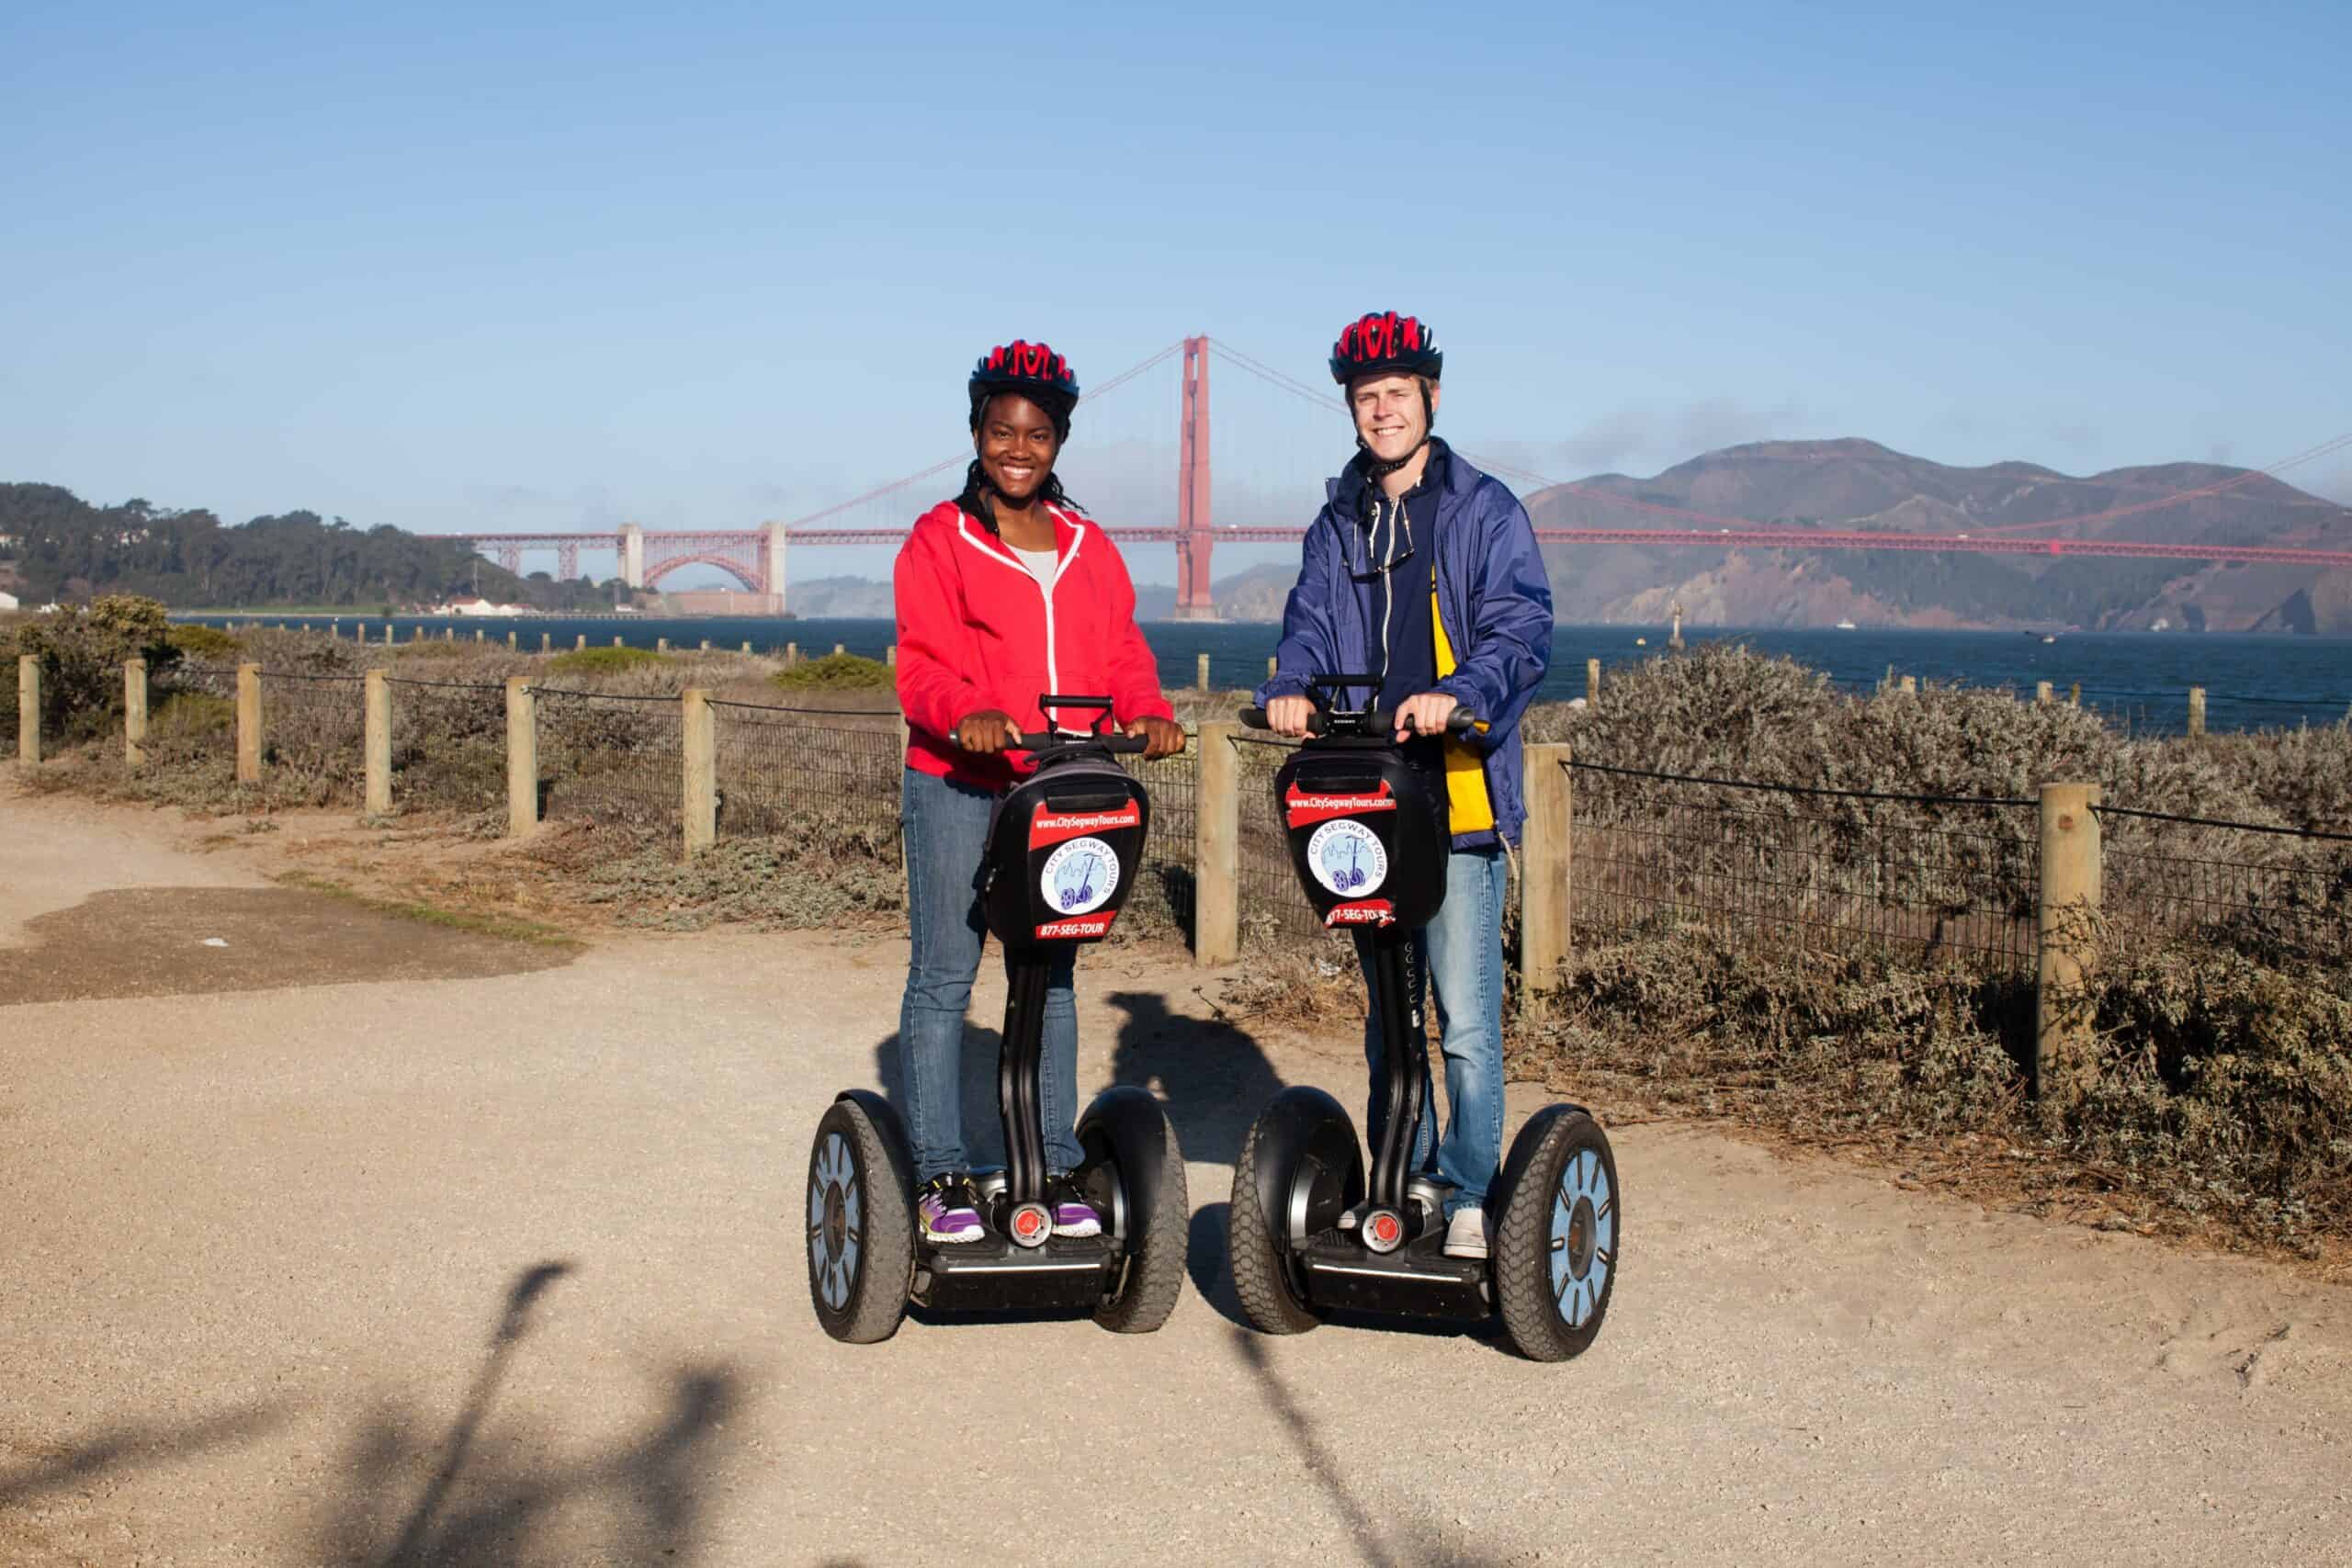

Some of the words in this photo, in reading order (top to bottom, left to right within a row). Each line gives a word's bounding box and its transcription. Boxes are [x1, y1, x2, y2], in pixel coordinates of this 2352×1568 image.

[1036, 816, 1135, 829] www.CitySegwayTours.com
[1310, 831, 1324, 854] CITY
[1324, 822, 1372, 839] SEGWAY
[1373, 840, 1384, 877] TOURS
[1046, 852, 1063, 874] CITY
[1064, 840, 1111, 855] SEGWAY
[1104, 858, 1117, 894] TOURS
[1041, 923, 1104, 936] 877-SEG-TOUR
